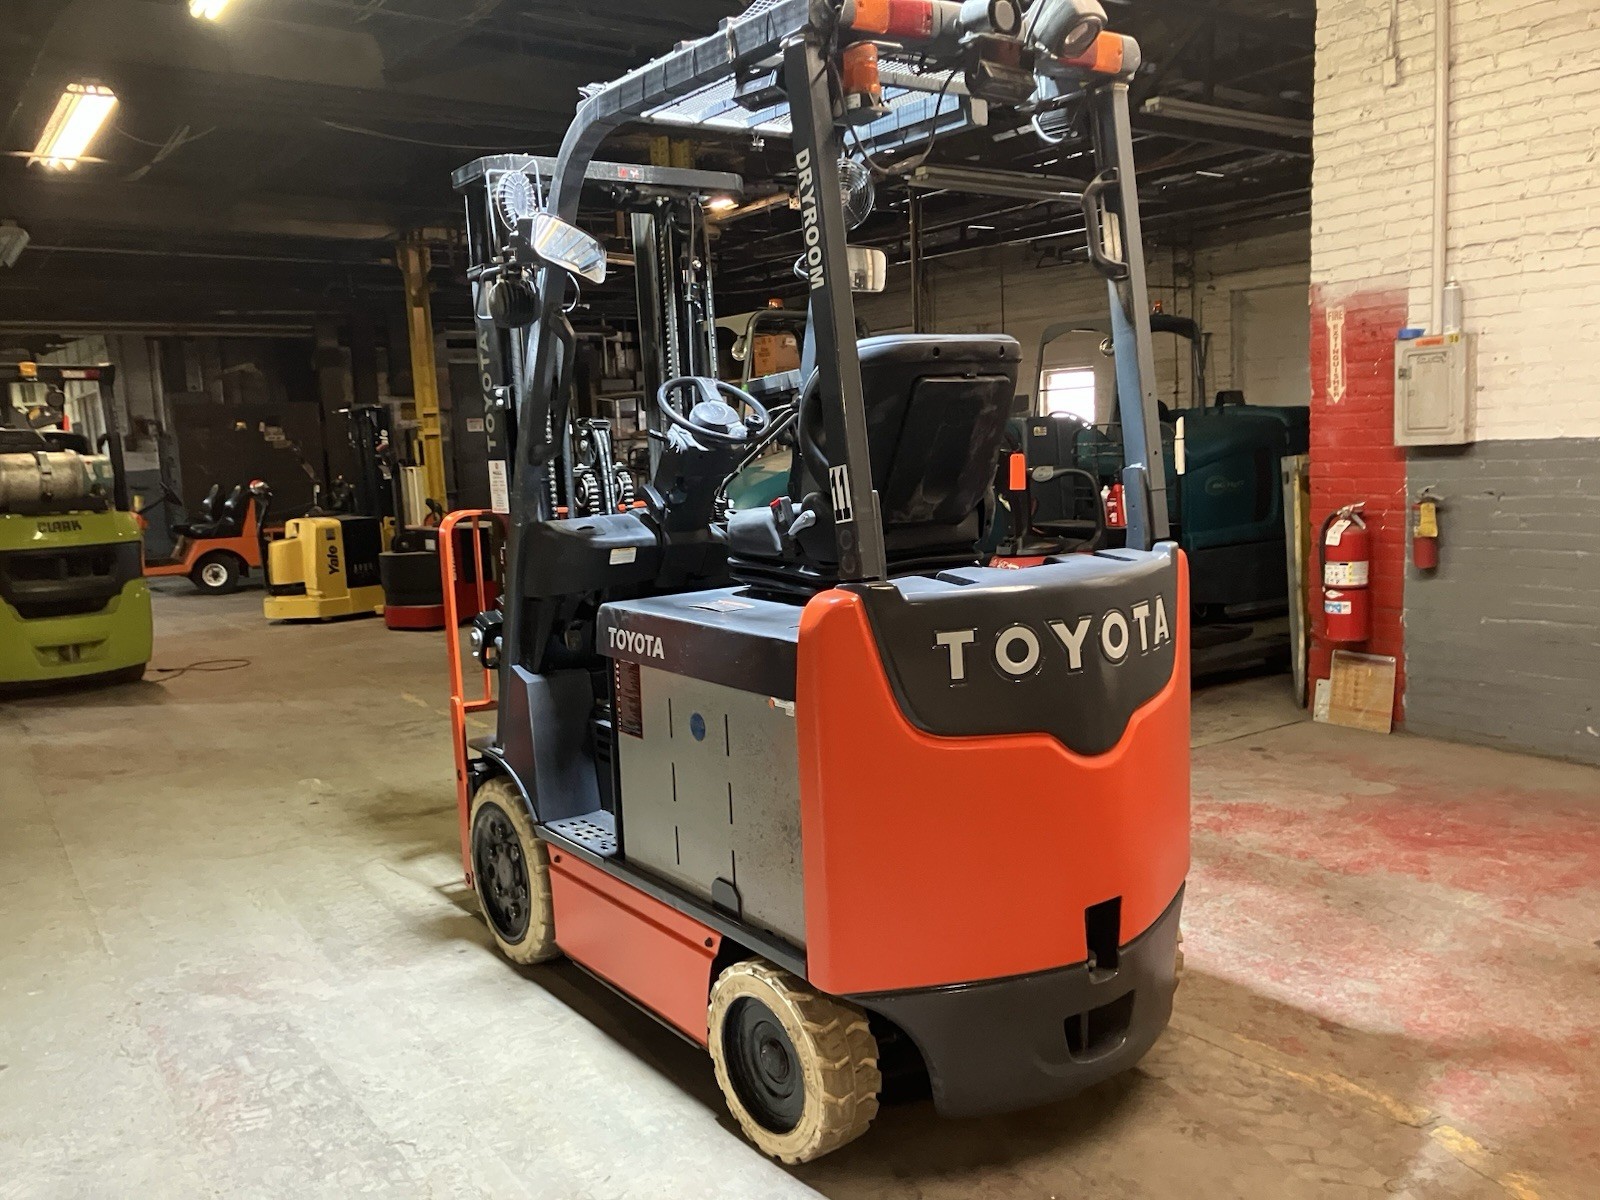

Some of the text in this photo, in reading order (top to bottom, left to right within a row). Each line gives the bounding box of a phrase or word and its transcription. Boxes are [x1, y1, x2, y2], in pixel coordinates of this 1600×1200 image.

[796, 148, 825, 290] DRYROOM
[1327, 310, 1344, 321] FIRE
[480, 331, 497, 453] TOYOTA
[327, 545, 340, 575] Yale
[608, 626, 665, 660] TOYOTA
[935, 595, 1170, 681] TOYOTA
